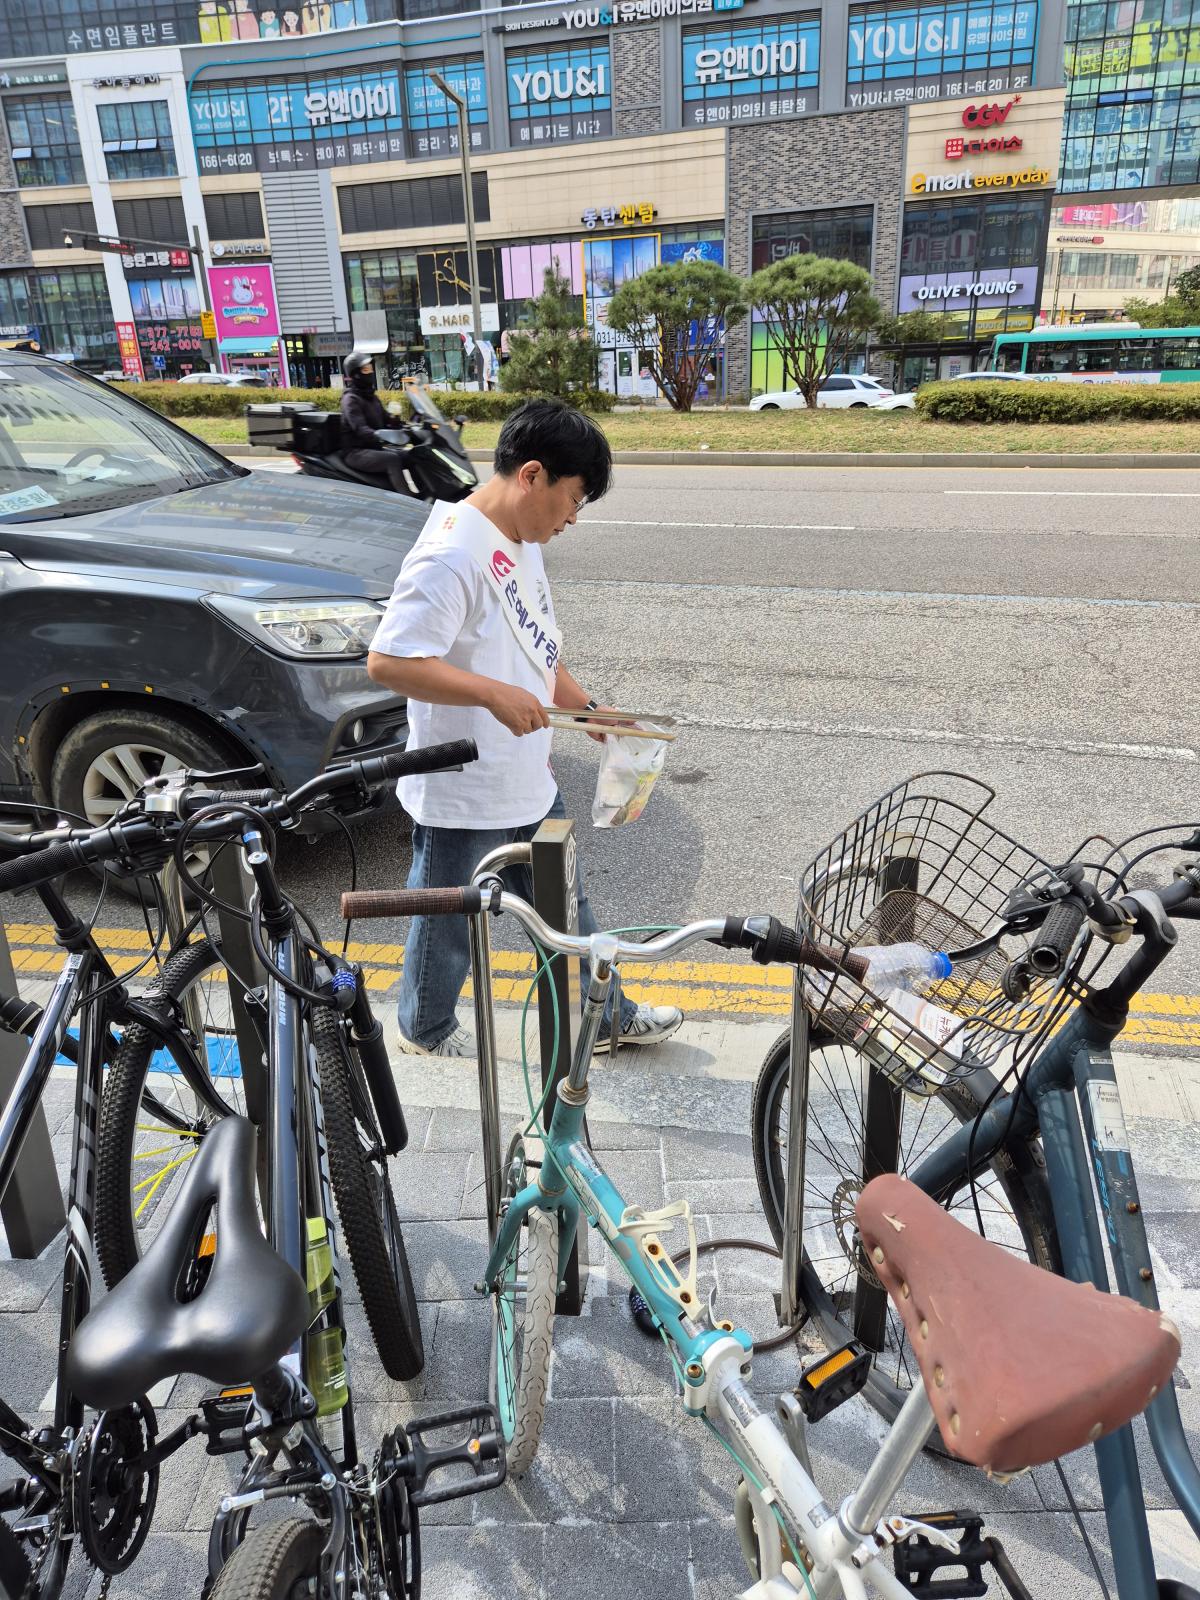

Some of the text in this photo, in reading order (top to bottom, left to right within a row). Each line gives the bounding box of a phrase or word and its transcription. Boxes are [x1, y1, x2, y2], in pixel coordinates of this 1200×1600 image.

[505, 18, 559, 31] SKIN DESIGN LAB
[562, 6, 619, 29] YOU&I
[68, 22, 177, 49] 수면임플란트
[851, 16, 960, 61] YOU&I
[695, 38, 807, 84] 유앤아이
[512, 64, 605, 104] YOU&I
[1014, 75, 1029, 89] 2F
[193, 100, 246, 120] YOU&I
[268, 96, 294, 123] 2F
[304, 81, 397, 126] 유앤아이
[962, 100, 1014, 129] CGV
[577, 119, 600, 135] 시간
[968, 135, 1023, 154] 다이소
[911, 166, 1050, 193] emart everyday
[918, 280, 1017, 300] OLIVE YOUNG
[504, 578, 559, 675] 은혜사랑
